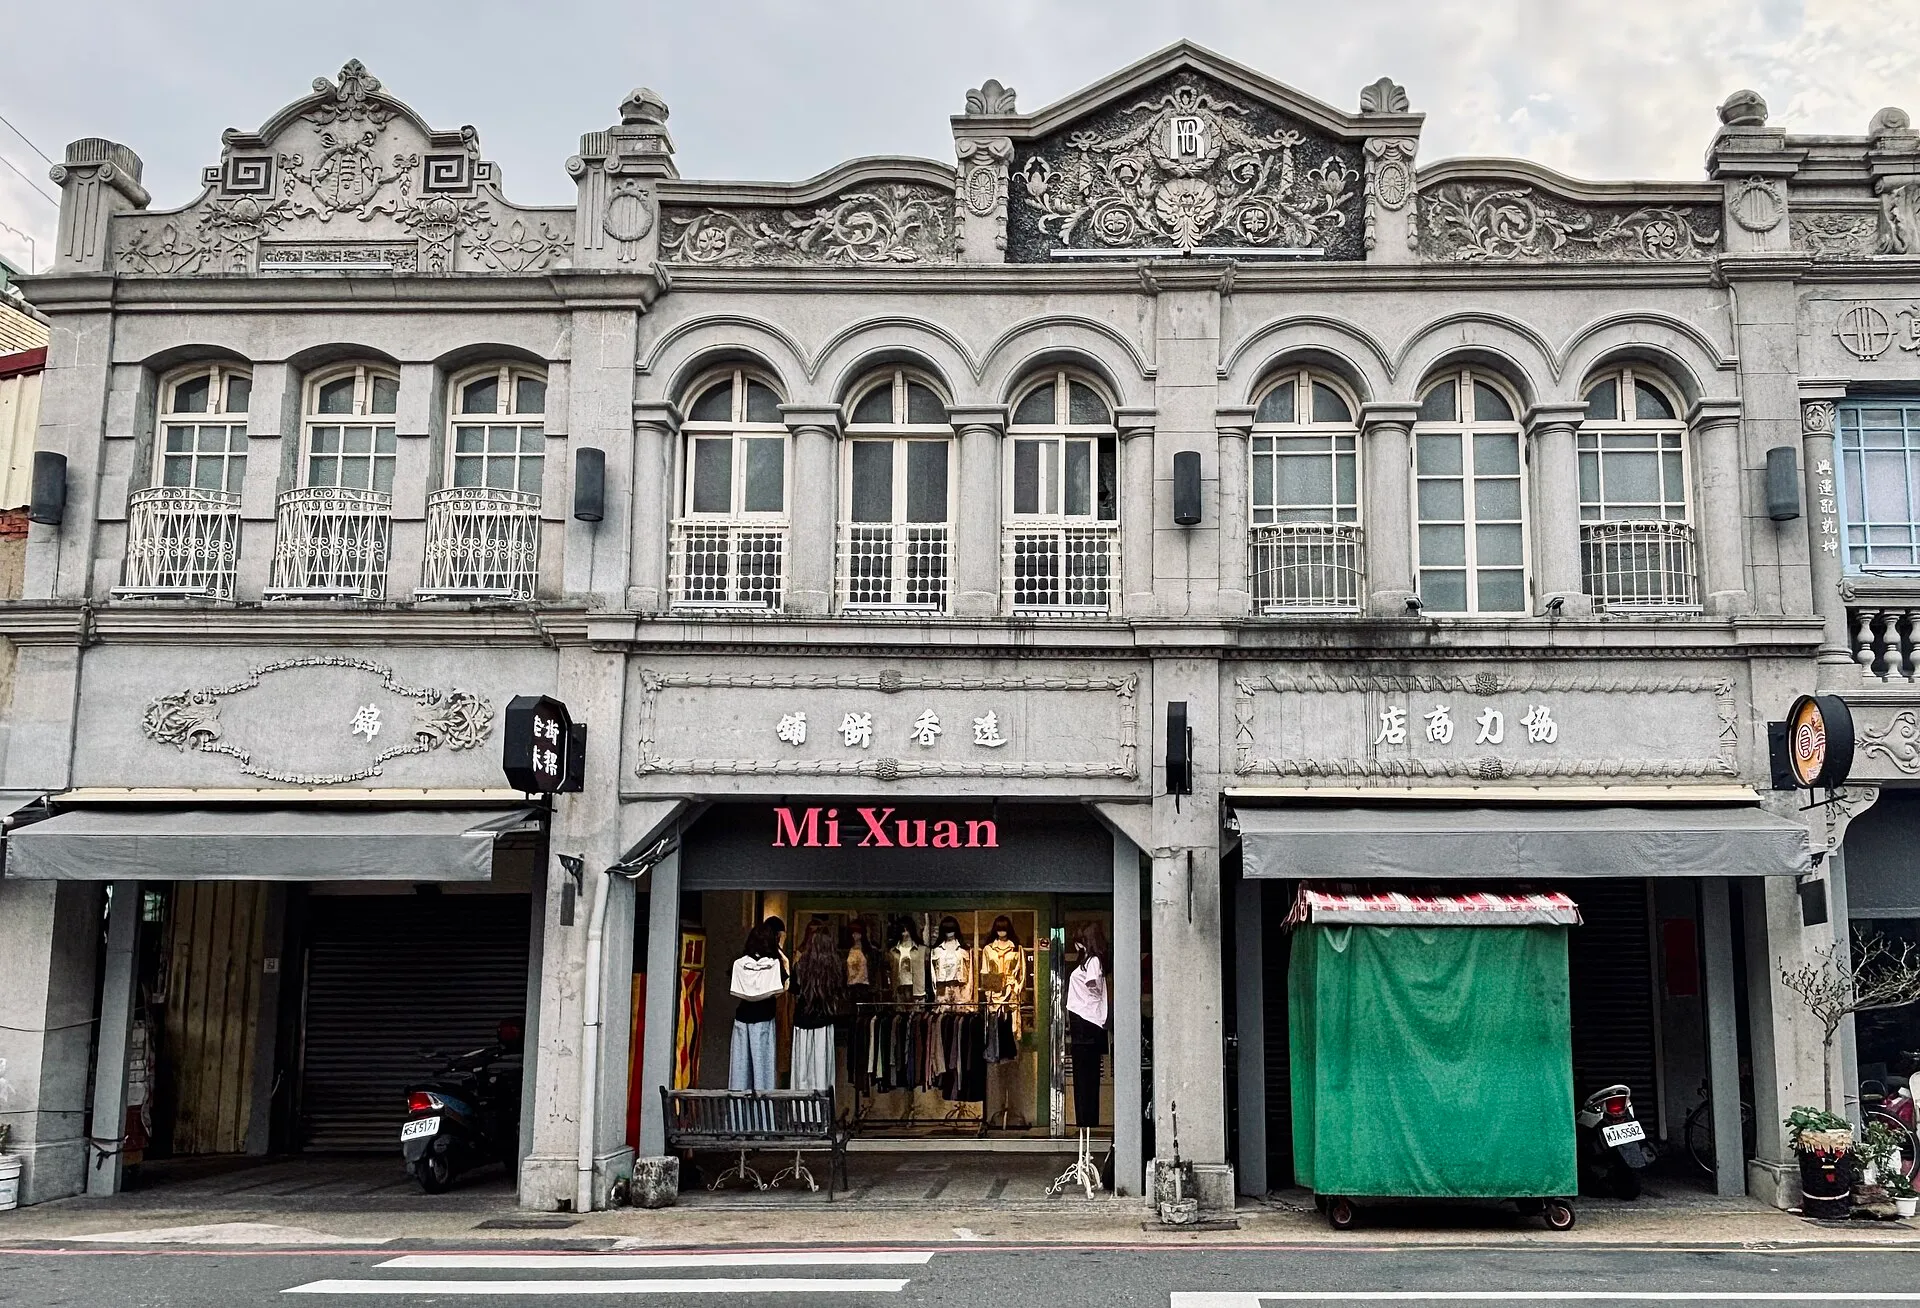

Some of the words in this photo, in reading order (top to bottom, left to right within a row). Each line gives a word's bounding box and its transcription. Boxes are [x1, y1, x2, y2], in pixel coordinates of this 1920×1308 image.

[349, 702, 382, 743] 錦
[772, 807, 842, 848] Mi
[856, 807, 999, 848] Xuan
